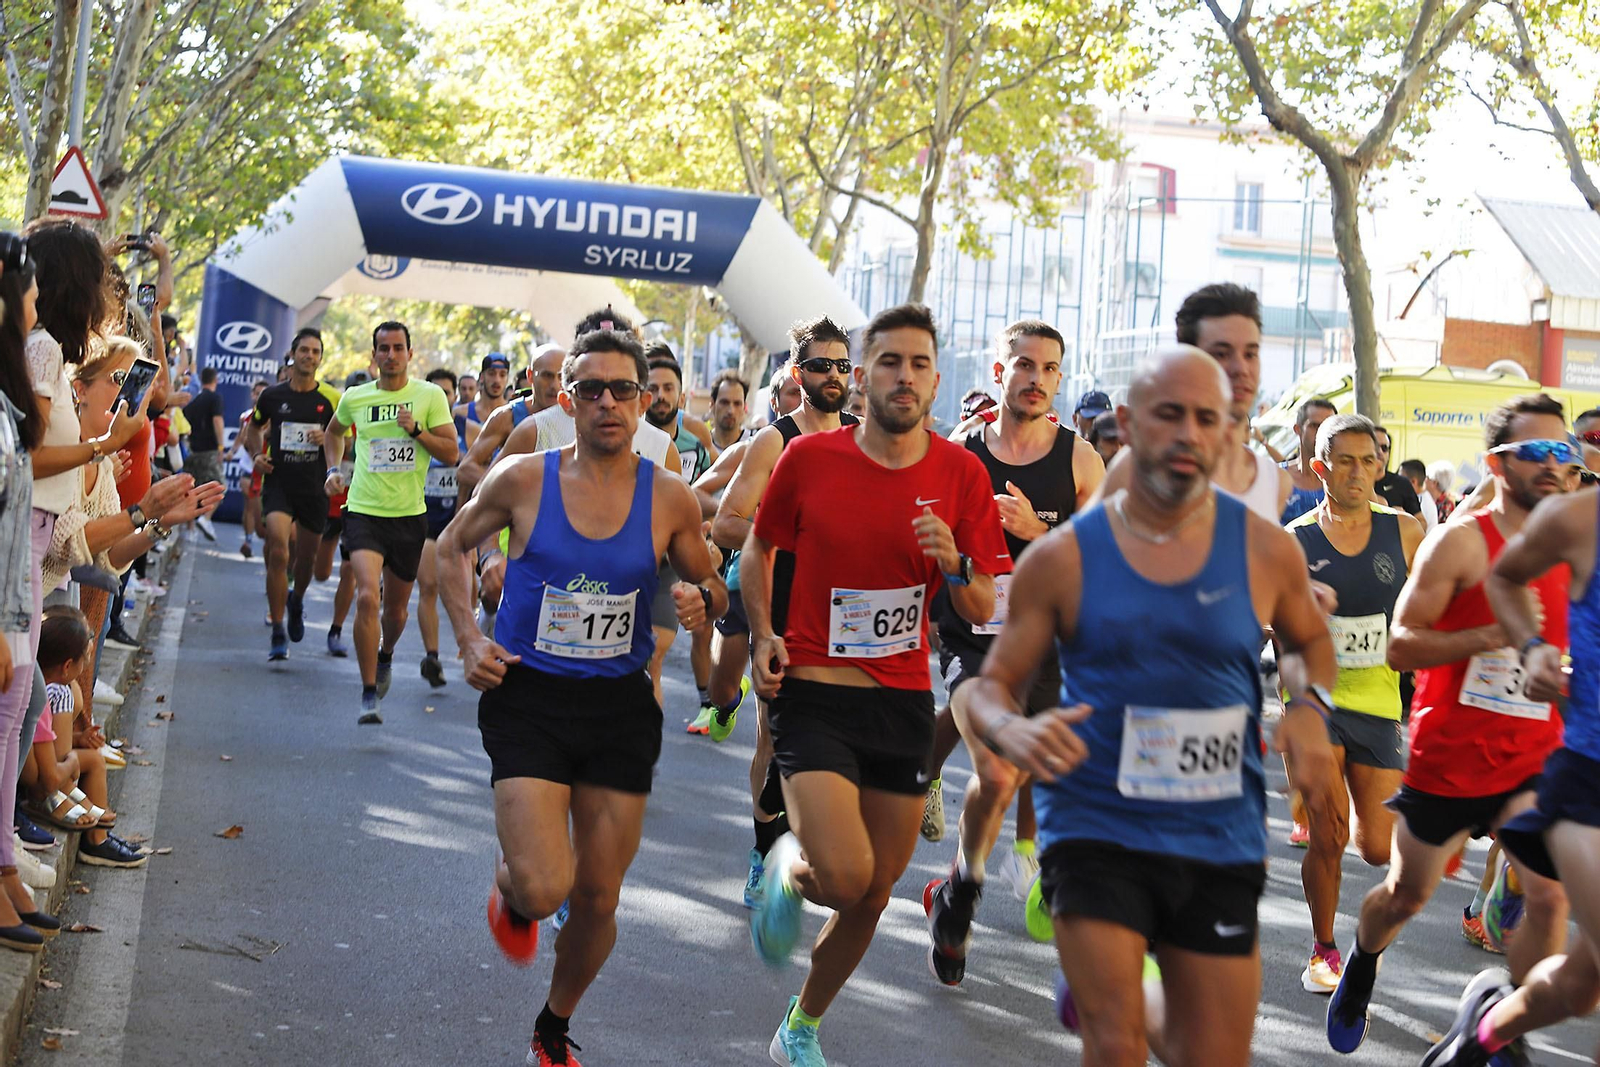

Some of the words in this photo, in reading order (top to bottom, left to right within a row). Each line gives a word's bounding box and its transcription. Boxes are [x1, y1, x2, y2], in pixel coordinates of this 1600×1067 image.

[493, 194, 698, 243] HYUNDAI
[584, 245, 693, 273] SYRLUZ
[205, 354, 279, 375] HYUNDAI
[216, 372, 265, 386] SYRLUZ
[1413, 408, 1473, 427] Soporte
[388, 446, 414, 462] 342
[606, 599, 631, 607] MANUEL
[582, 611, 631, 640] 173
[873, 604, 918, 638] 629
[1345, 629, 1382, 652] 247
[1177, 731, 1239, 775] 586
